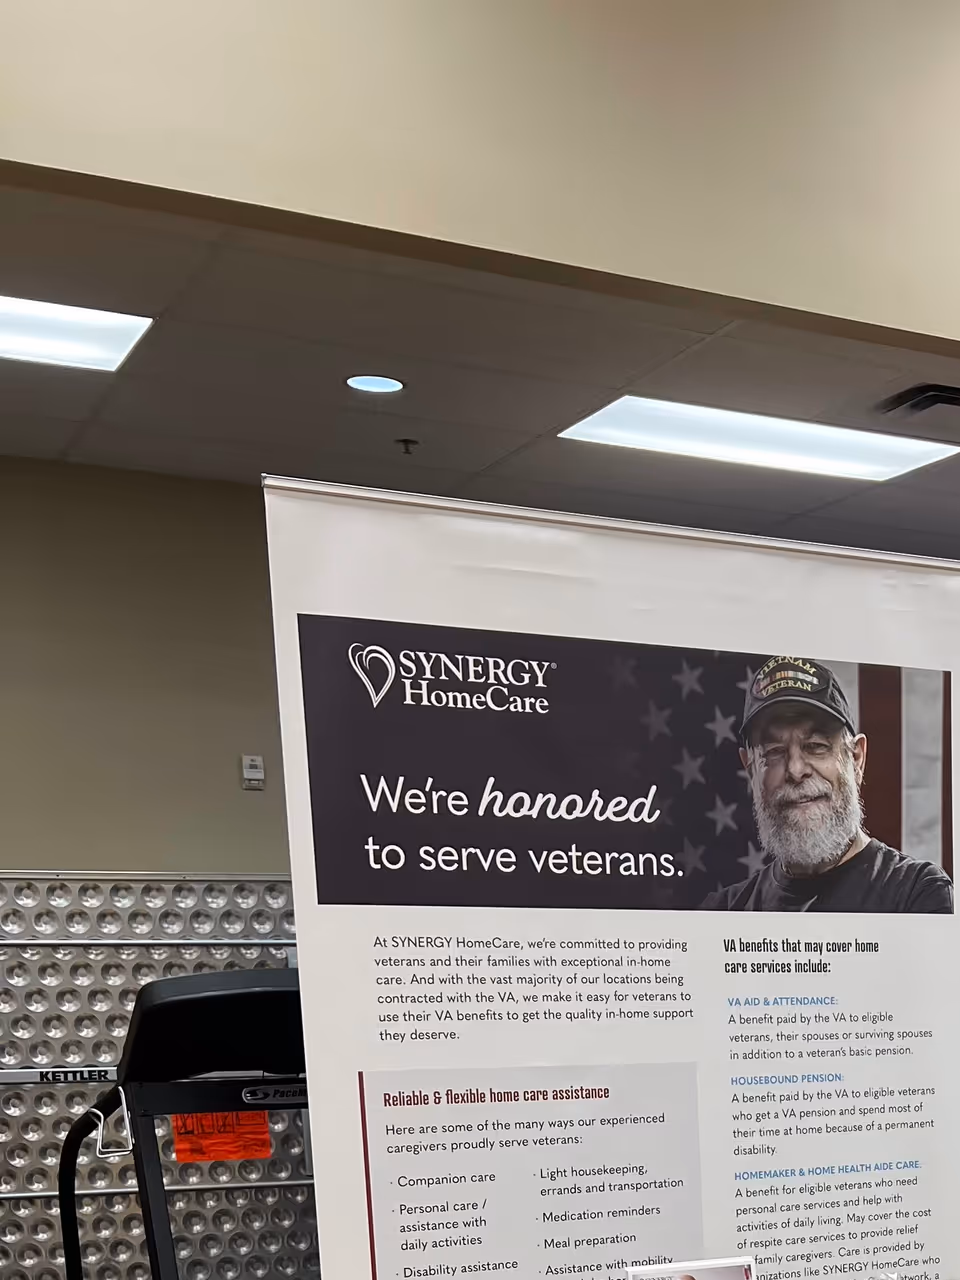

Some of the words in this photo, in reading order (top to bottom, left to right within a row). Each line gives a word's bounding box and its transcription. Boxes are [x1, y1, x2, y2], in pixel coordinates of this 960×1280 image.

[758, 656, 817, 681] VIETNAM
[402, 679, 549, 714] HomeCare
[760, 680, 813, 697] VETERAN
[360, 774, 469, 815] We're
[478, 776, 661, 824] honored
[365, 837, 405, 870] to
[419, 844, 516, 873] serve
[528, 847, 685, 878] veterans.
[373, 935, 388, 948] At
[391, 935, 452, 948] SYNERGY
[456, 936, 524, 950] HomeCare,
[527, 937, 556, 949] we're
[559, 938, 620, 949] committed
[623, 939, 635, 949] to
[638, 938, 688, 952] providing
[723, 938, 737, 952] VA
[739, 937, 779, 952] benefits
[781, 937, 802, 953] that
[804, 941, 823, 956] may
[825, 941, 852, 953] cover
[854, 937, 879, 952] home
[373, 956, 425, 967] veterans
[429, 954, 451, 966] and
[454, 955, 483, 966] their
[486, 954, 530, 967] families
[533, 955, 557, 967] with
[560, 955, 623, 969] exceptional
[626, 955, 671, 967] in-home
[724, 962, 747, 973] care
[750, 959, 792, 973] services
[794, 958, 831, 973] include:
[375, 976, 406, 985] care.
[409, 973, 434, 985] And
[438, 973, 463, 985] with
[466, 973, 486, 985] the
[489, 974, 513, 985] vast
[516, 973, 562, 988] majority
[565, 972, 577, 984] of
[580, 976, 600, 984] our
[603, 972, 651, 984] locations
[654, 972, 684, 987] being
[377, 991, 443, 1004] contracted
[446, 991, 471, 1003] with
[474, 991, 495, 1003] the
[497, 991, 519, 1004] VA,
[522, 994, 538, 1002] we
[542, 990, 572, 1002] make
[575, 991, 583, 1002] it
[586, 993, 610, 1004] easy
[613, 989, 629, 1002] for
[631, 992, 677, 1001] veterans
[679, 991, 691, 1001] to
[727, 997, 742, 1006] VA
[743, 997, 760, 1006] AID
[763, 996, 770, 1006] &
[378, 1013, 399, 1022] use
[402, 1010, 431, 1022] their
[434, 1009, 453, 1021] VA
[456, 1008, 503, 1021] benefits
[506, 1010, 519, 1020] to
[522, 1010, 540, 1023] get
[542, 1008, 562, 1020] the
[565, 1007, 602, 1022] quality
[605, 1007, 650, 1019] in-home
[652, 1008, 694, 1020] support
[727, 1014, 737, 1024] A
[739, 1012, 774, 1025] benefit
[776, 1012, 797, 1026] paid
[799, 1012, 812, 1026] by
[814, 1012, 830, 1023] the
[832, 1012, 847, 1022] VA
[849, 1013, 859, 1022] to
[861, 1011, 894, 1025] eligible
[379, 1028, 406, 1043] they
[410, 1028, 460, 1040] deserve.
[39, 1070, 109, 1082] KETTLER
[730, 1074, 799, 1086] HOUSEBOUND
[383, 1089, 429, 1107] Reliable
[433, 1090, 442, 1105] &
[444, 1087, 486, 1105] flexible
[489, 1087, 519, 1103] home
[523, 1089, 548, 1102] care
[551, 1085, 609, 1100] assistance
[385, 1124, 415, 1135] Here
[418, 1125, 438, 1134] are
[441, 1123, 473, 1133] some
[476, 1119, 489, 1132] of
[491, 1119, 511, 1131] the
[514, 1121, 544, 1131] many
[547, 1119, 574, 1130] ways
[577, 1118, 596, 1127] our
[599, 1112, 665, 1128] experienced
[386, 1140, 447, 1155] caregivers
[450, 1137, 495, 1153] proudly
[498, 1138, 529, 1148] serve
[532, 1135, 583, 1146] veterans:
[540, 1167, 568, 1182] Light
[570, 1163, 648, 1177] housekeeping,
[734, 1168, 796, 1181] HOMEMAKER
[798, 1167, 805, 1177] &
[807, 1165, 835, 1176] HOME
[837, 1163, 871, 1174] HEALTH
[873, 1161, 893, 1171] AIDE
[397, 1173, 467, 1188] Companion
[470, 1173, 496, 1183] care
[540, 1183, 582, 1196] errands
[585, 1181, 605, 1193] and
[608, 1177, 683, 1192] transportation
[542, 1209, 603, 1223] Medication
[607, 1205, 660, 1218] reminders
[403, 1264, 457, 1278] Disability
[460, 1260, 518, 1273] assistance
